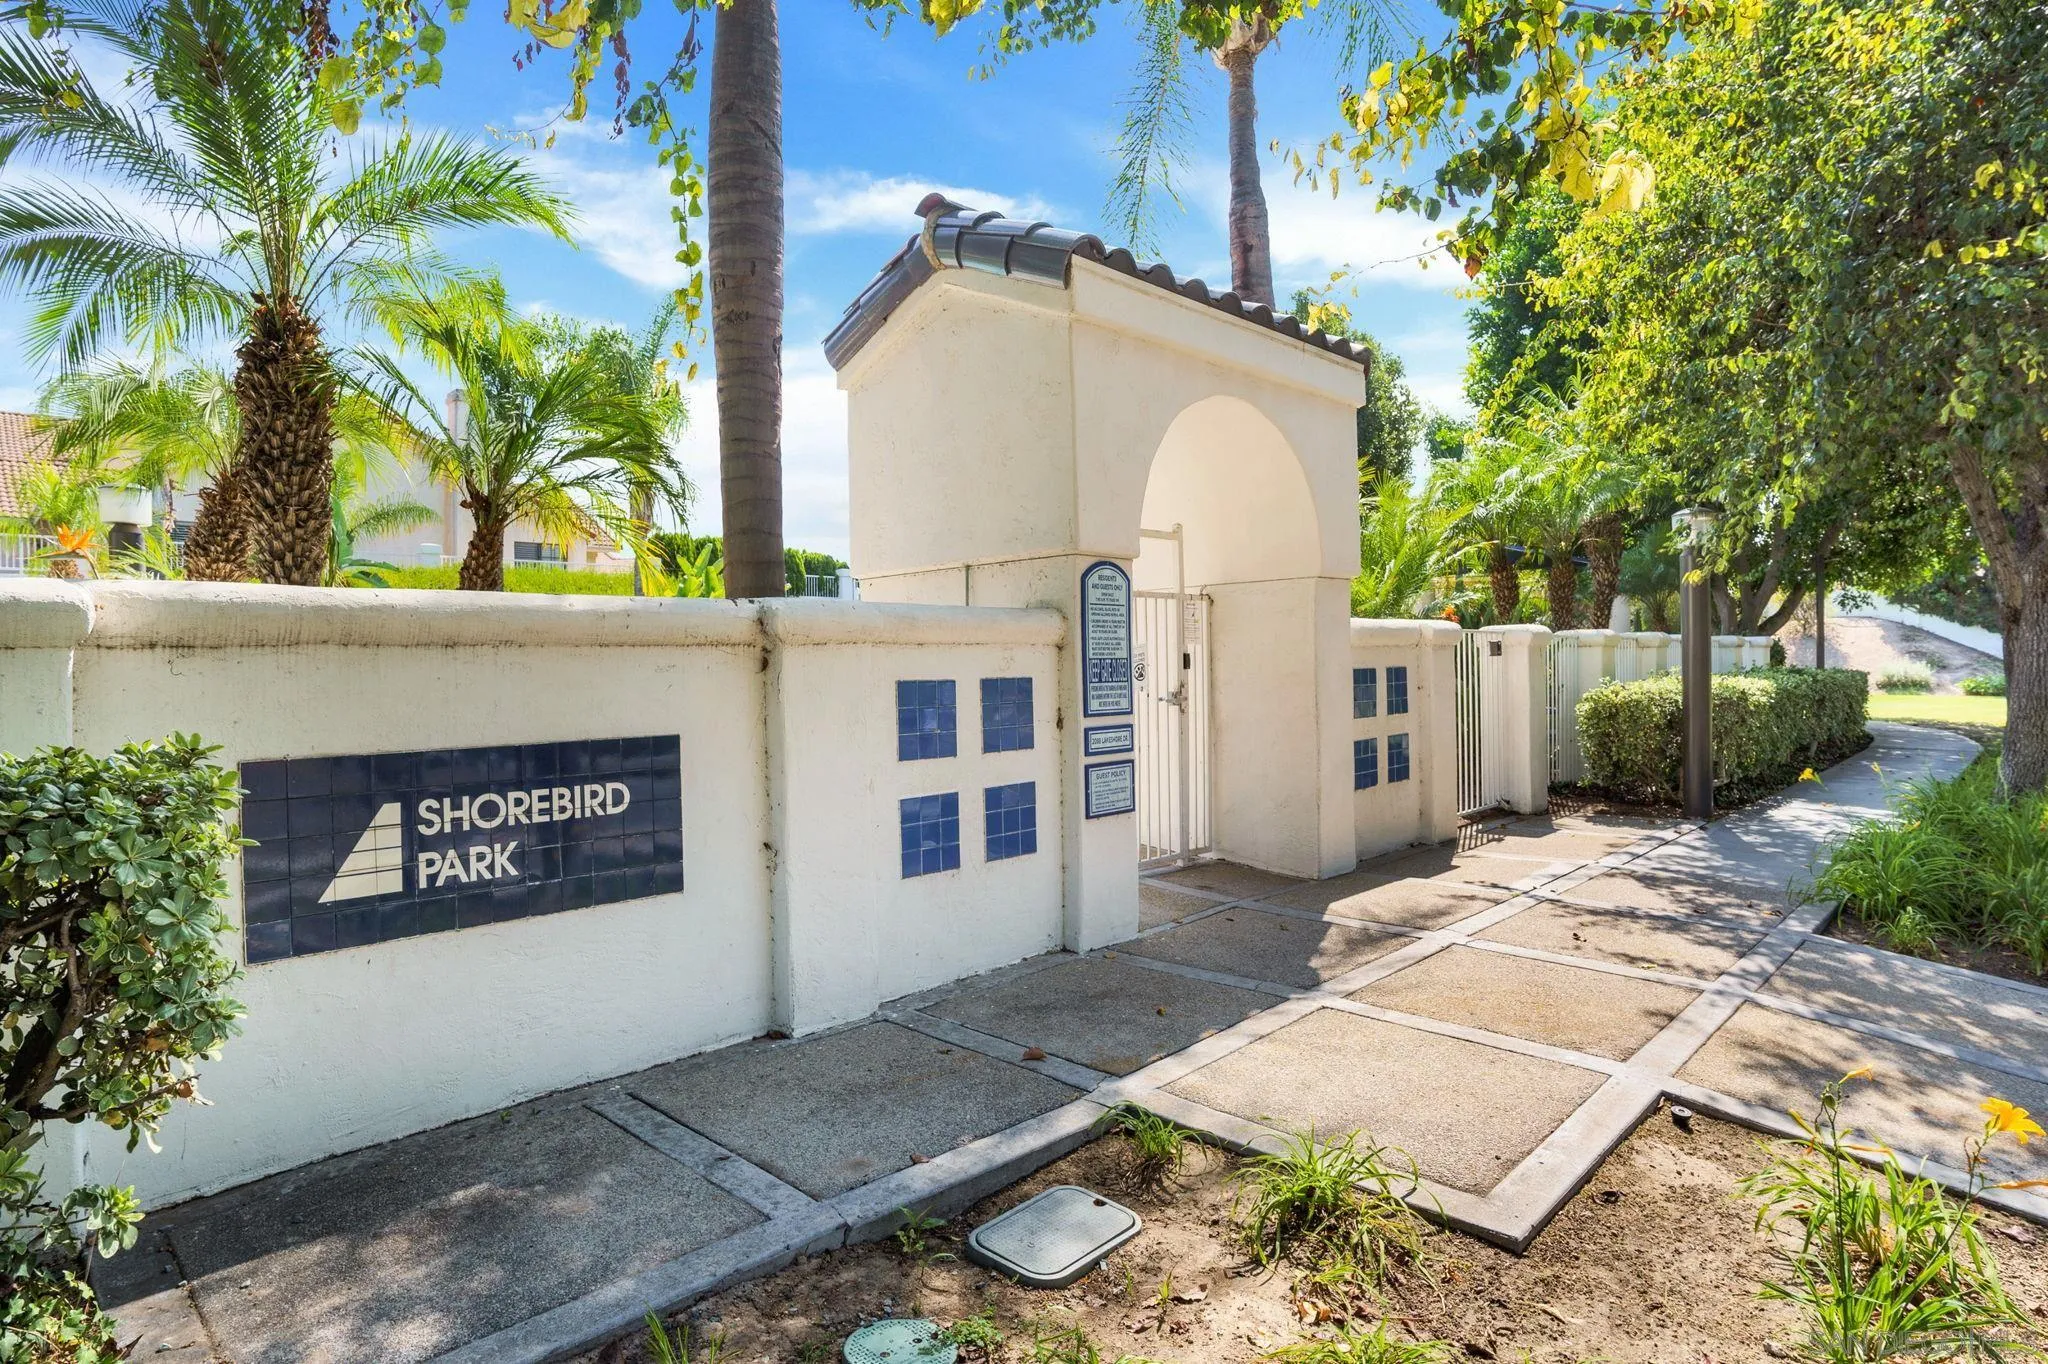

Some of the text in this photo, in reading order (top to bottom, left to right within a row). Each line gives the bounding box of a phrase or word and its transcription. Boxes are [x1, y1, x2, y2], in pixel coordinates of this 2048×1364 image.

[1096, 770, 1126, 780] GUEST POLICY
[417, 781, 631, 836] SHOREBIRD
[418, 841, 519, 889] PARK
